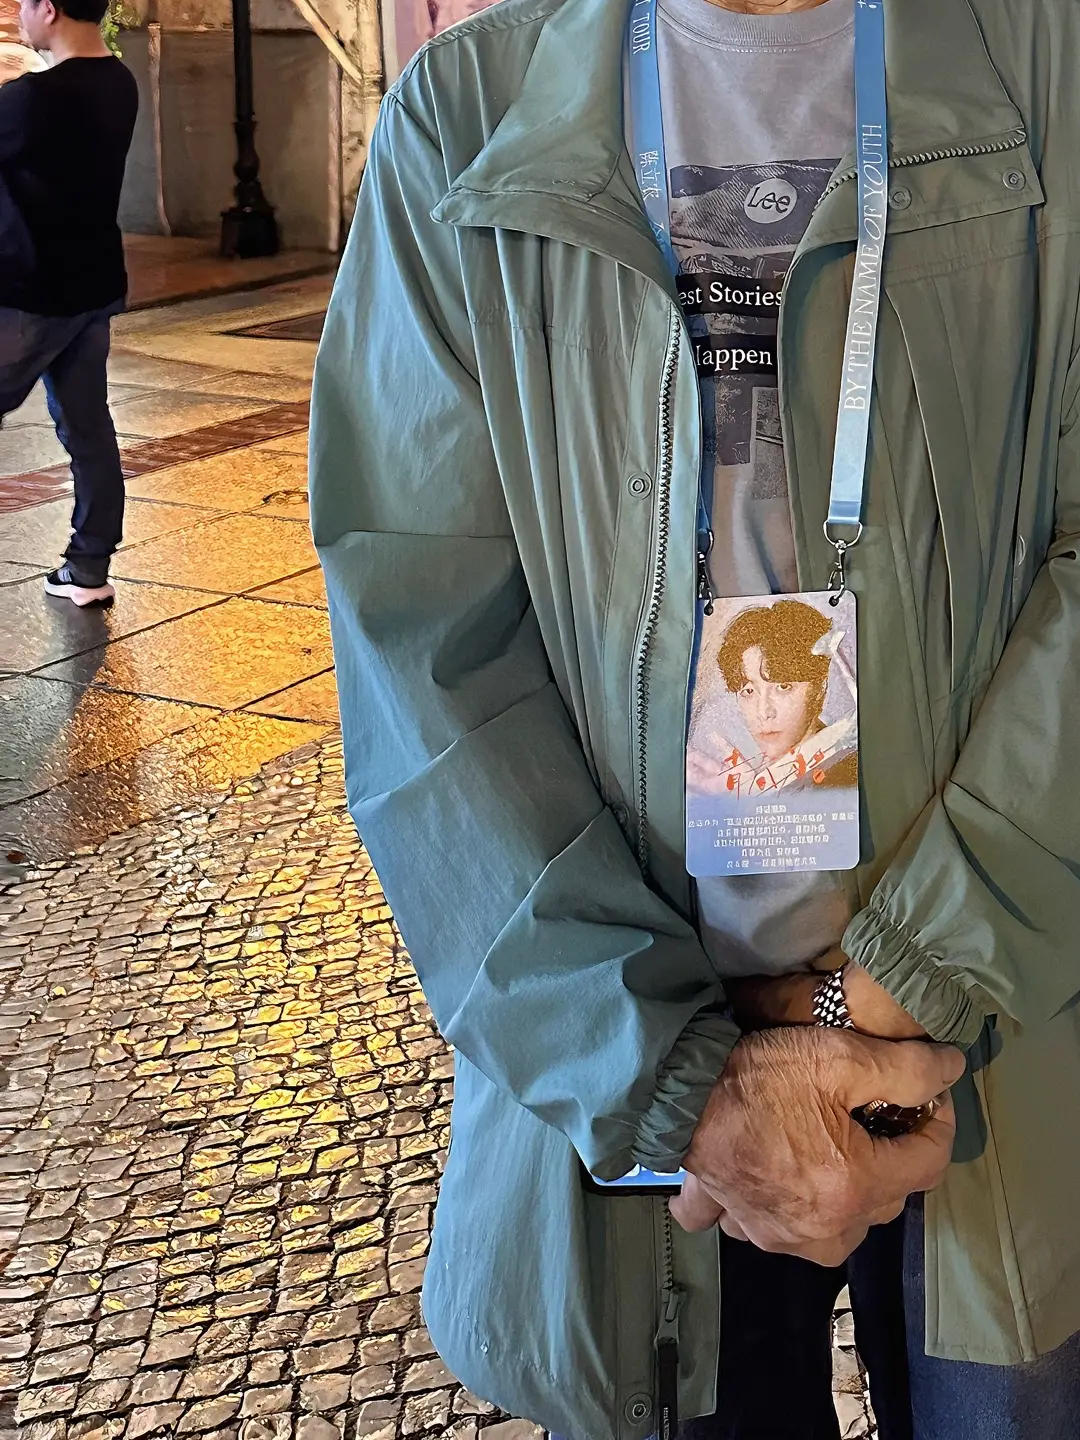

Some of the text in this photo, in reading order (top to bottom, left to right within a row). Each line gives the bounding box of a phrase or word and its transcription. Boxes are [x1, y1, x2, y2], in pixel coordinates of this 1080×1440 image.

[632, 13, 651, 55] TOUR
[747, 186, 792, 213] Lee
[843, 124, 885, 410] BY THE NAME OF YOUTH
[708, 281, 784, 307] Stories
